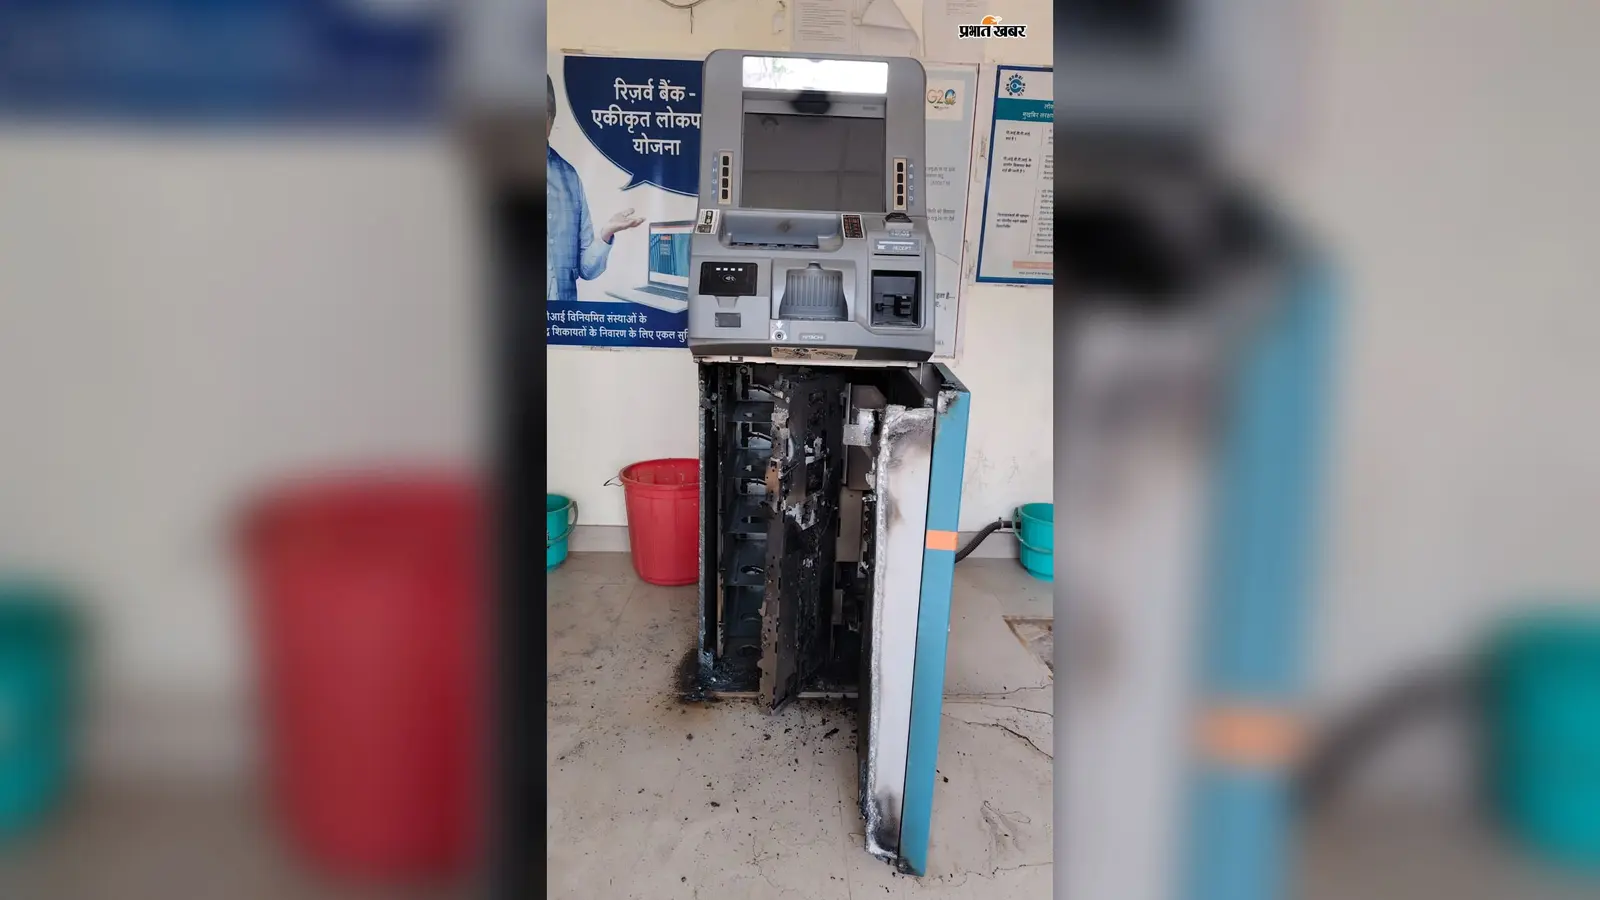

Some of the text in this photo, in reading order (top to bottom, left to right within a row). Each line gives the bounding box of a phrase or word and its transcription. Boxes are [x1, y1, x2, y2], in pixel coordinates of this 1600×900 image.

[614, 77, 654, 103] रिज़र्व
[658, 79, 686, 102] बैंक
[591, 104, 651, 134] एकीकृत
[632, 132, 681, 155] योजना
[567, 310, 605, 322] विनियमित
[606, 311, 637, 323] संस्थाओं
[638, 312, 648, 323] के
[551, 324, 587, 337] शिकायतों
[589, 325, 597, 337] के
[599, 326, 627, 338] निवारण
[628, 327, 637, 339] के
[639, 327, 654, 340] लिए
[655, 330, 676, 340] एकल
